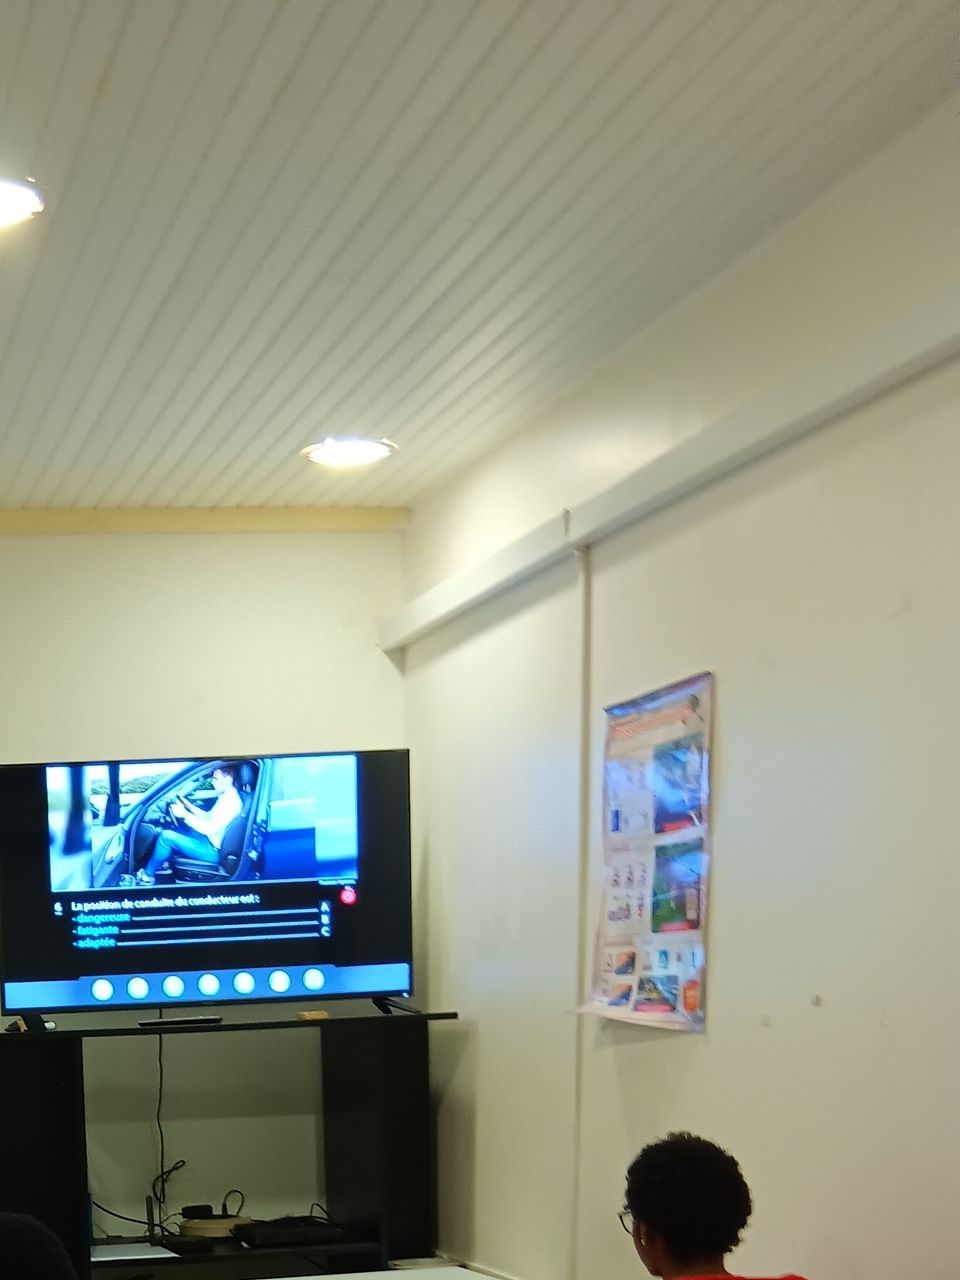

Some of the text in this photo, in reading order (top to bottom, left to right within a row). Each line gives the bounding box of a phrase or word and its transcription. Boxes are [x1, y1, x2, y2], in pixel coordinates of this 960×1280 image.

[83, 900, 121, 912] position
[121, 898, 134, 909] de
[134, 897, 175, 909] conduite
[175, 896, 189, 907] du
[189, 894, 239, 906] conducteur
